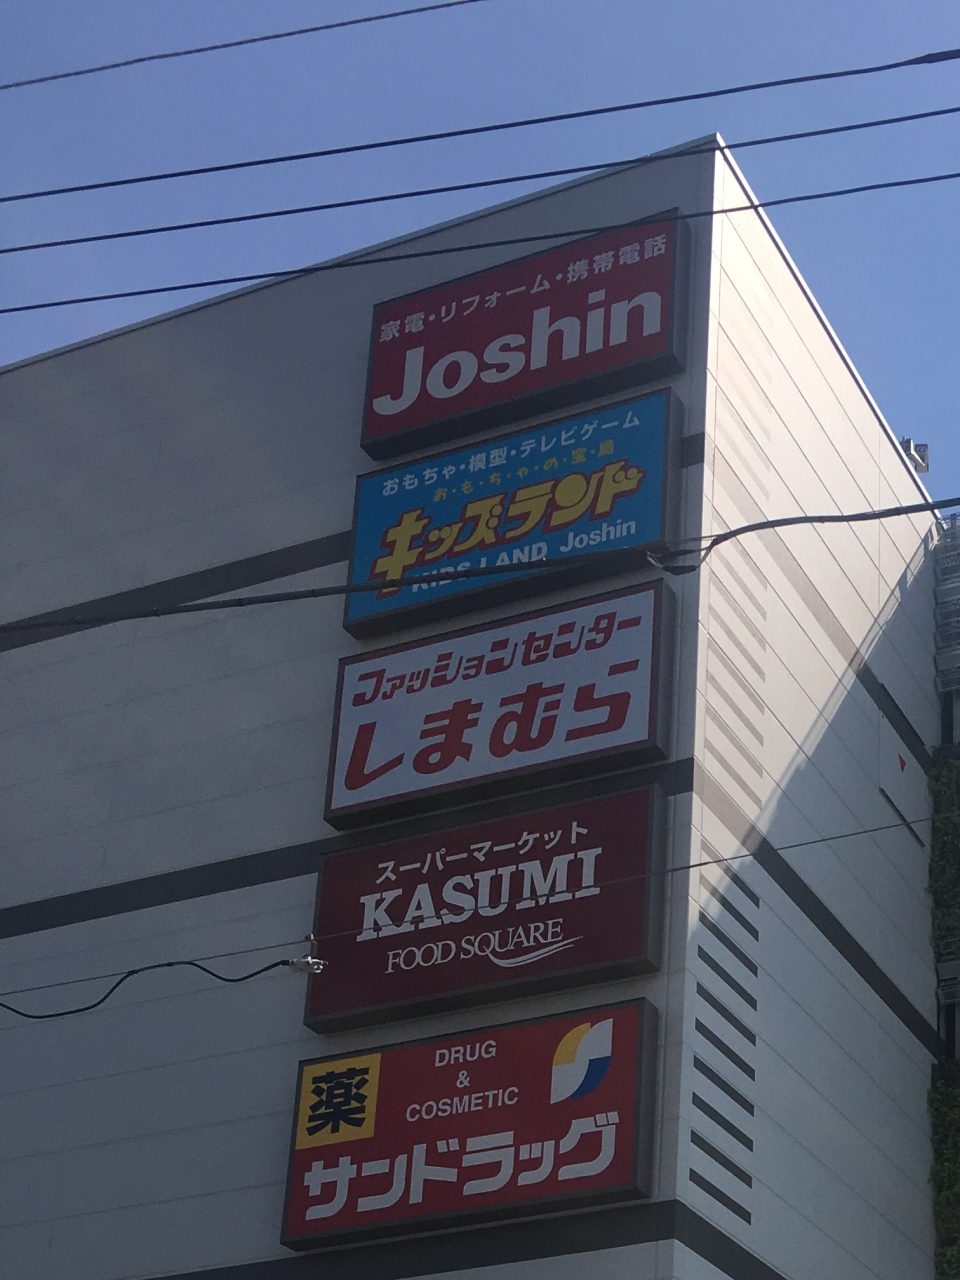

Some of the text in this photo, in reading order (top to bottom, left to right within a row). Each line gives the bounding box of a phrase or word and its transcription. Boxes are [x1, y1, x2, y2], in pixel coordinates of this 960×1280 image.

[379, 233, 668, 343] 家電・リフォーム・携帯電話
[372, 289, 662, 417] Joshin
[381, 410, 640, 497] おもちゃ・模型・テレビゲーム
[374, 459, 646, 595] キッズランド
[559, 519, 637, 553] Joshin
[351, 611, 642, 707] ファッションセンター
[343, 658, 640, 791] しまむら
[356, 847, 603, 943] KASUMI
[375, 821, 589, 885] スーパーマーケット
[385, 918, 566, 974] FOOD SQUARE
[434, 1040, 497, 1068] DRUG
[455, 1071, 470, 1088] &
[305, 1066, 370, 1137] 薬
[405, 1087, 520, 1123] COSMETIC
[303, 1111, 620, 1221] サンドラッグ
